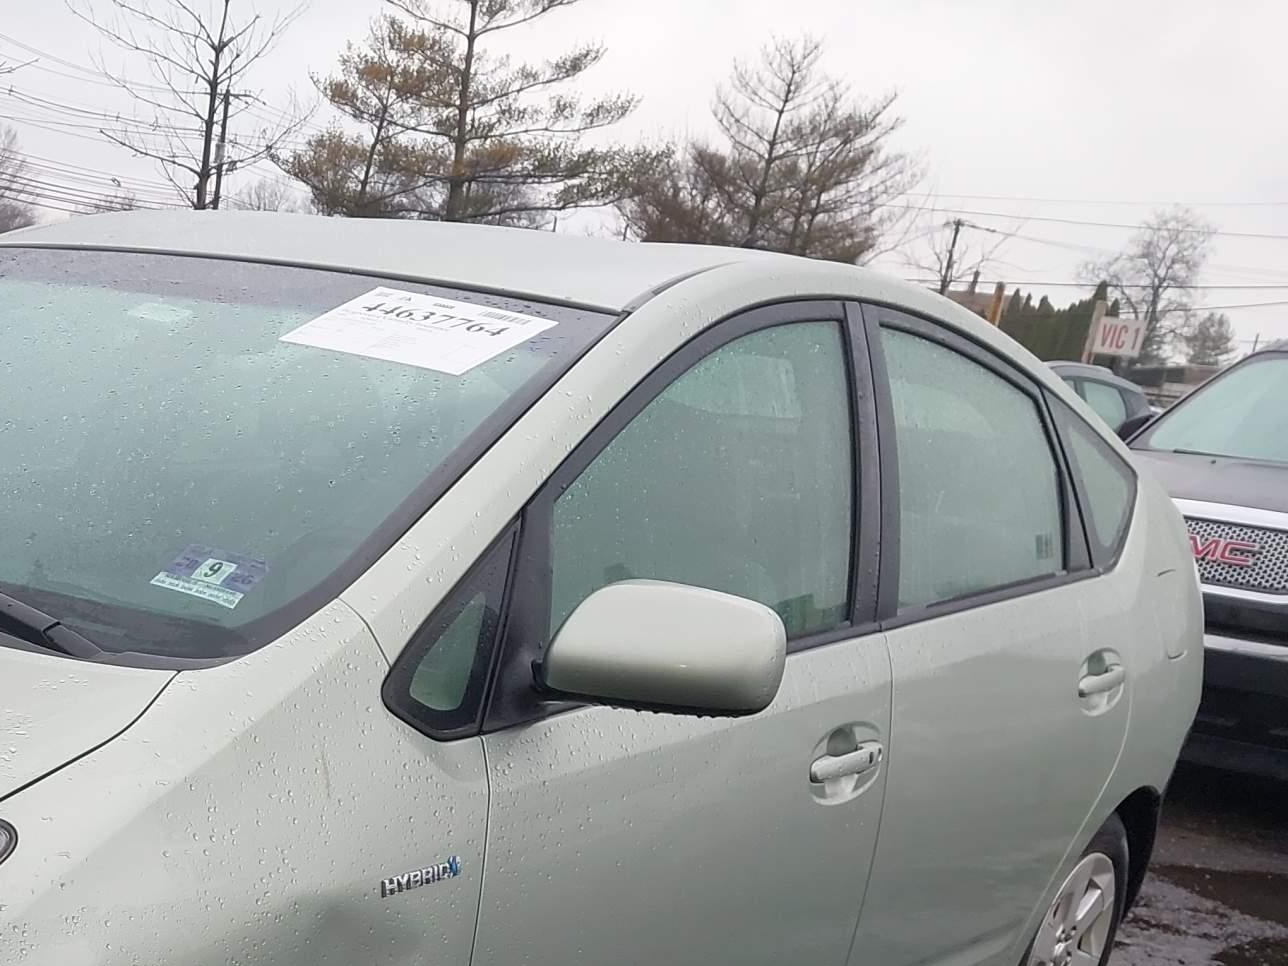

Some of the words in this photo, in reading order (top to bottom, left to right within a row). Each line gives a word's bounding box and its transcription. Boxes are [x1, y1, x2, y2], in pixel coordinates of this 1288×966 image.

[362, 302, 510, 337] 44637764
[1100, 322, 1129, 350] VIC
[1131, 328, 1141, 351] 1
[1188, 534, 1257, 567] MC
[203, 561, 224, 578] 9
[381, 861, 452, 898] HYBRID
